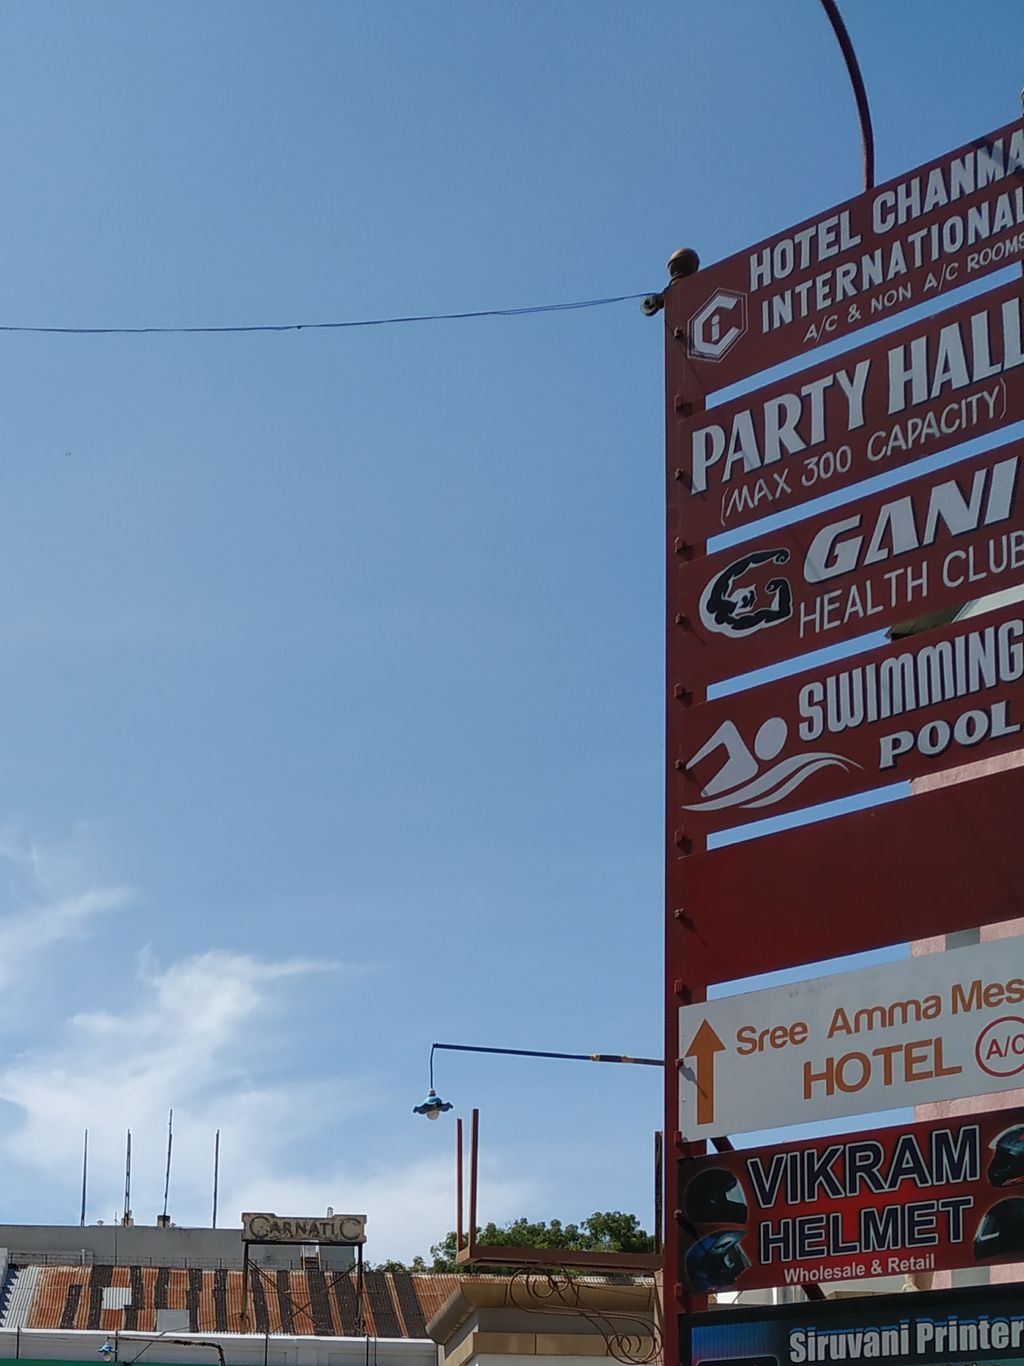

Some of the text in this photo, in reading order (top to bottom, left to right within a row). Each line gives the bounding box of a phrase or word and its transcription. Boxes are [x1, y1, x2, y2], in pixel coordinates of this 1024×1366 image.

[749, 128, 1024, 292] HOTEL CHANMA
[803, 314, 838, 343] A/C
[847, 307, 862, 323] &
[870, 282, 913, 314] NON
[922, 260, 959, 293] A/C
[690, 296, 1024, 497] PARTY HALL
[720, 378, 1007, 527] (MAX 300 CAPACITY)
[803, 455, 1019, 584] GANI
[799, 529, 1024, 639] HEALTH CLUB
[797, 618, 1024, 742] SWIMMING
[878, 700, 1022, 770] POOL
[736, 1021, 808, 1056] Sree
[827, 994, 943, 1039] Amma
[803, 1036, 963, 1100] HOTEL
[747, 1124, 980, 1209] VIKRAM
[249, 1215, 361, 1241] CARNATIC
[760, 1195, 974, 1265] HELMET
[784, 1254, 935, 1284] Wholesale & Retail
[789, 1319, 910, 1363] Siruvani
